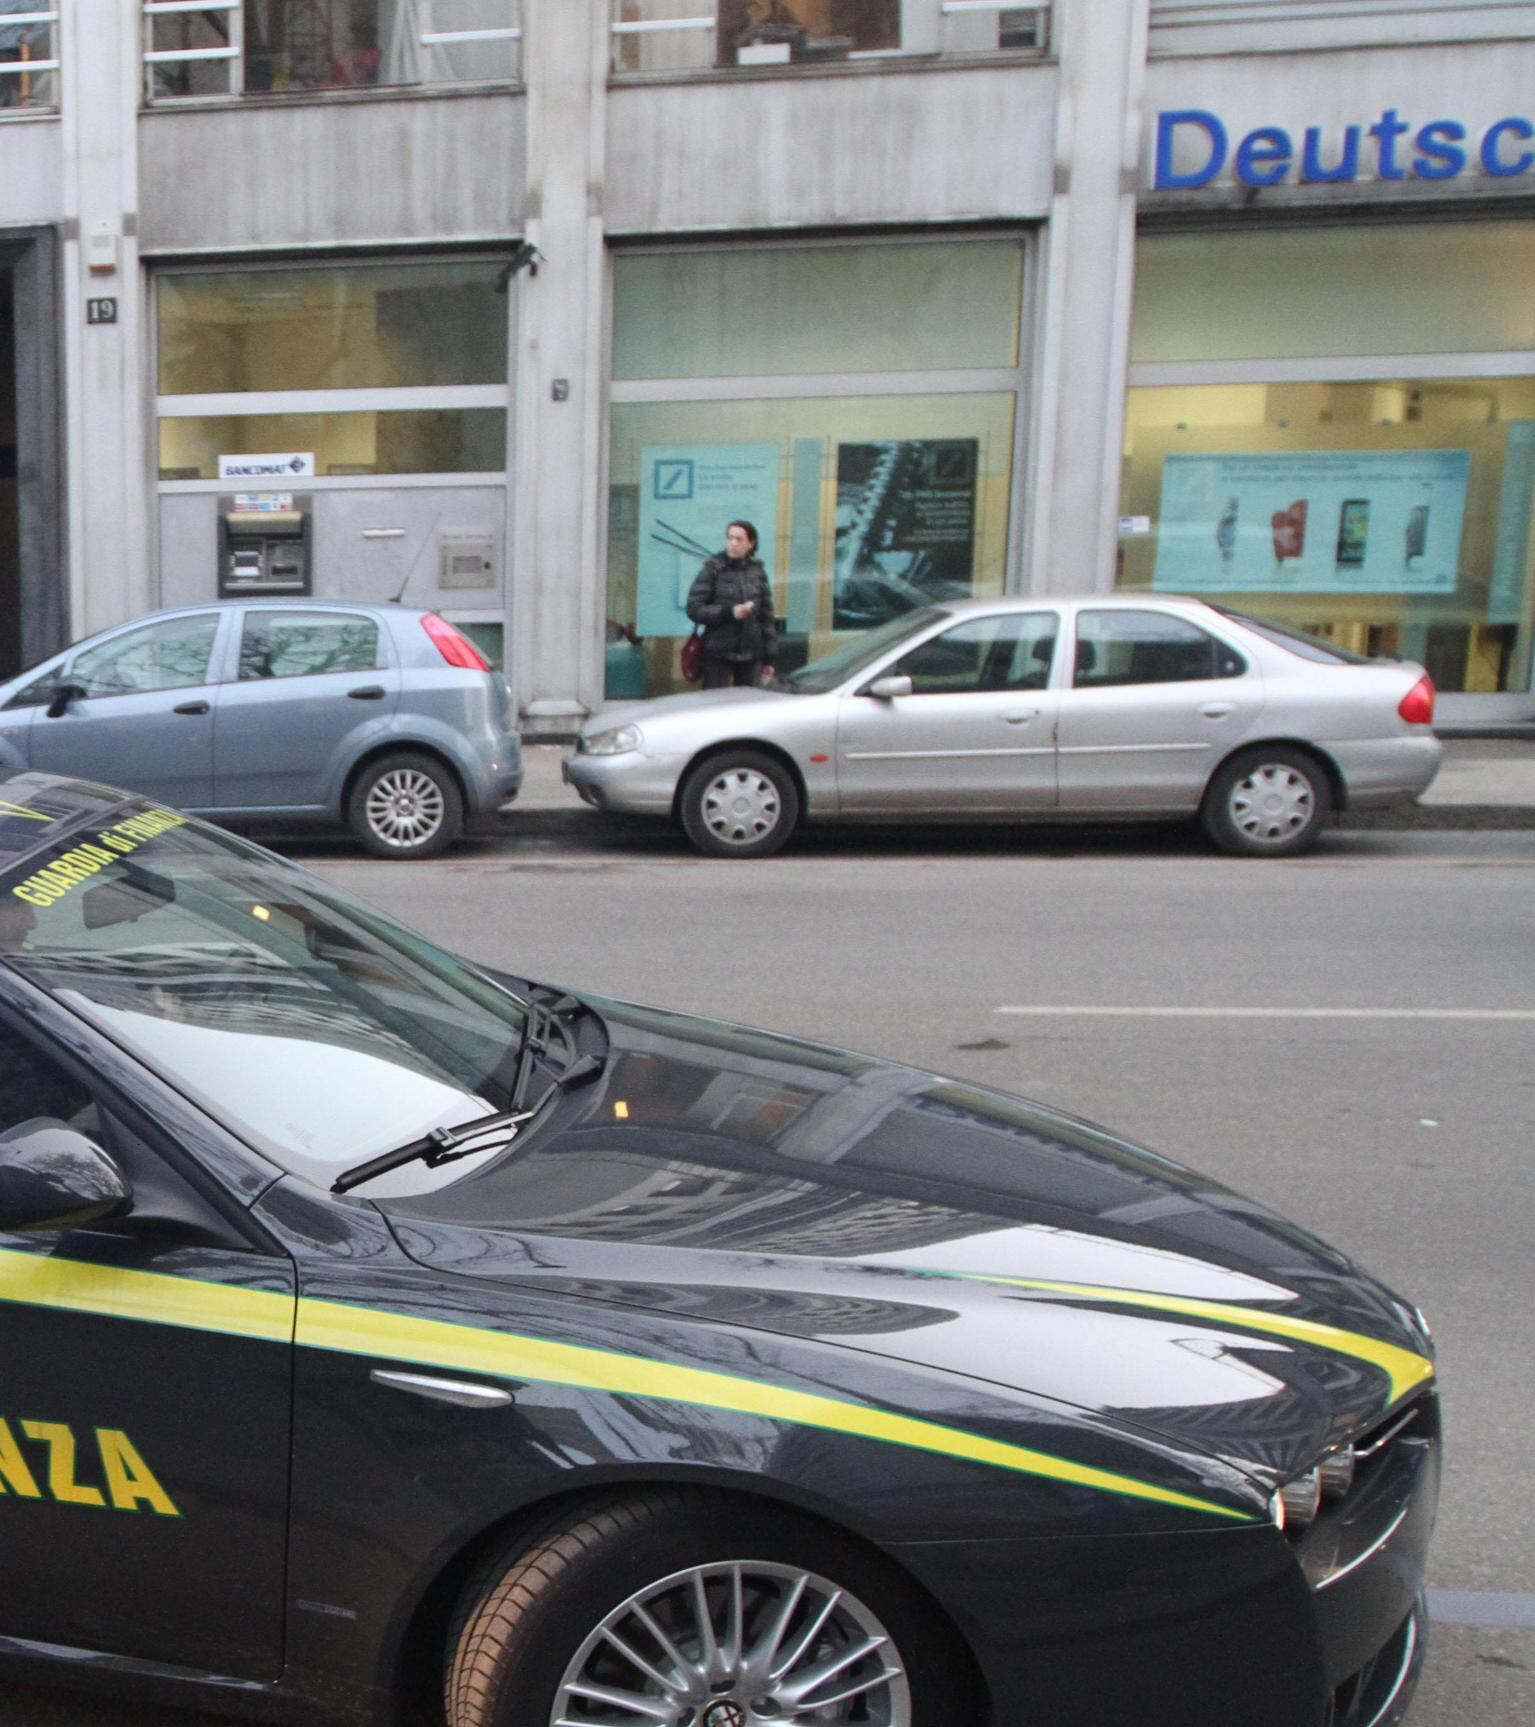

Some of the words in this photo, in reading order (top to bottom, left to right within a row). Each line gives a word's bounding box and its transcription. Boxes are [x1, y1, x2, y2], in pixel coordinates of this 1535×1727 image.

[1154, 109, 1534, 190] Deutsc
[91, 300, 114, 319] 19
[12, 842, 120, 907] GUARDIA
[97, 831, 138, 853] di
